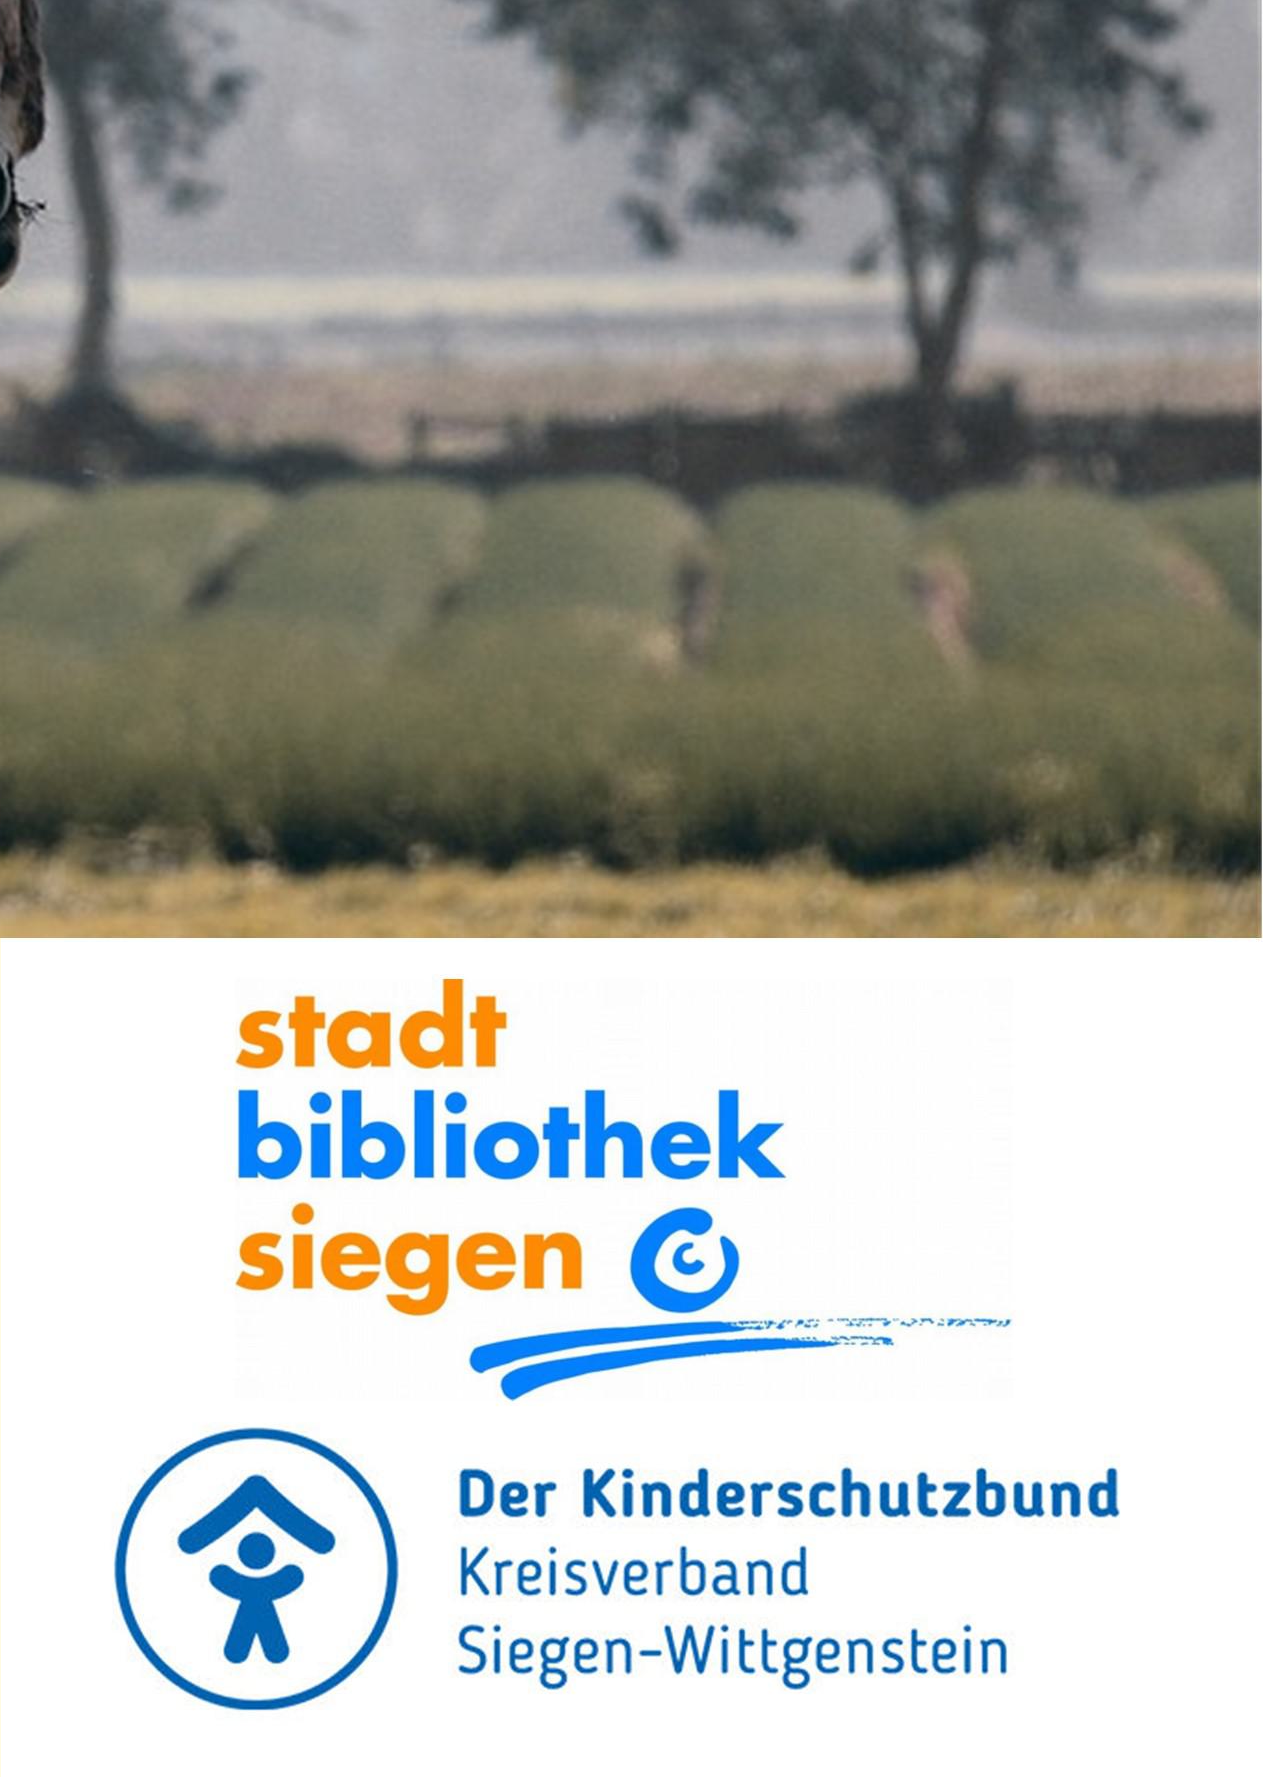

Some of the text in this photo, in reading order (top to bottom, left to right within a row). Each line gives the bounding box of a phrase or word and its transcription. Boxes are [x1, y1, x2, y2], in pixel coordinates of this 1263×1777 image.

[236, 979, 507, 1069] stadt
[238, 1090, 785, 1180] bibliothek
[236, 1203, 582, 1316] siegen
[460, 1468, 1119, 1517] Der Kinderschutzbund
[461, 1546, 808, 1596] Kreisverband
[459, 1625, 1008, 1689] Siegen-Wittgenstein
